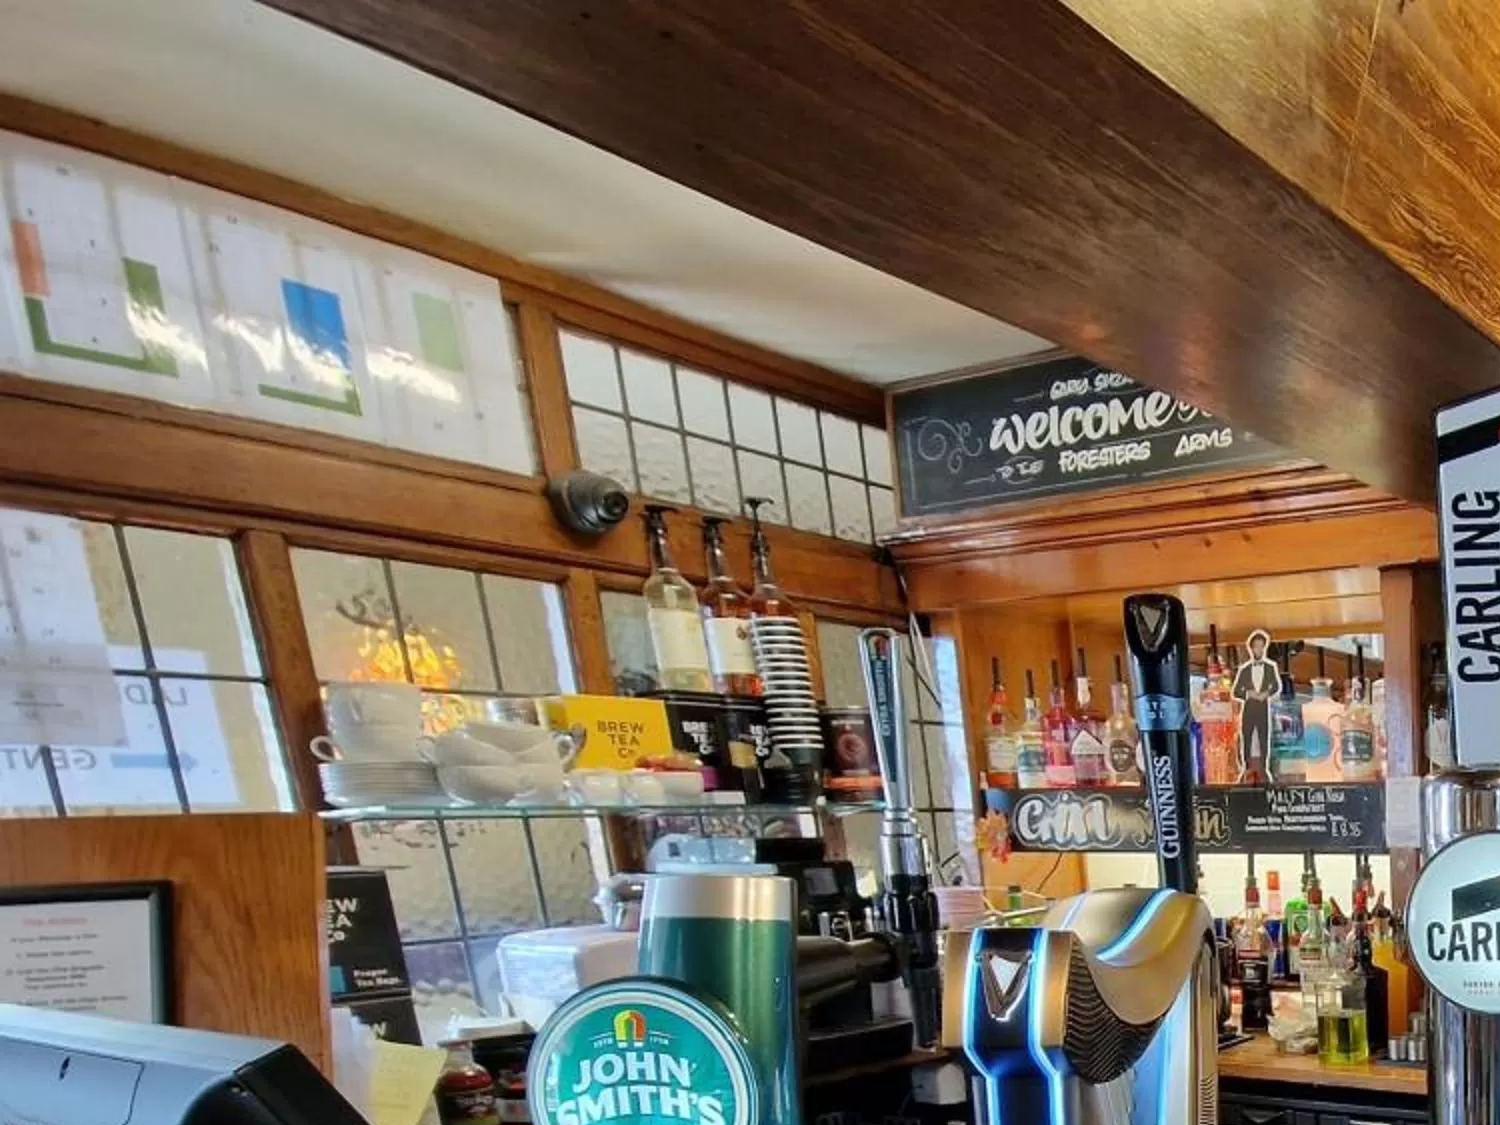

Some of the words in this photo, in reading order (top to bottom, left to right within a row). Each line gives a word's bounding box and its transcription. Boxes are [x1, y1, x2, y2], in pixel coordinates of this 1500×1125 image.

[1058, 441, 1151, 473] FORESTERS
[1173, 427, 1233, 458] ARMS
[597, 720, 645, 733] BREW
[607, 734, 641, 747] TEA
[1154, 755, 1181, 859] GUINNESS
[572, 1051, 692, 1093] JOHN
